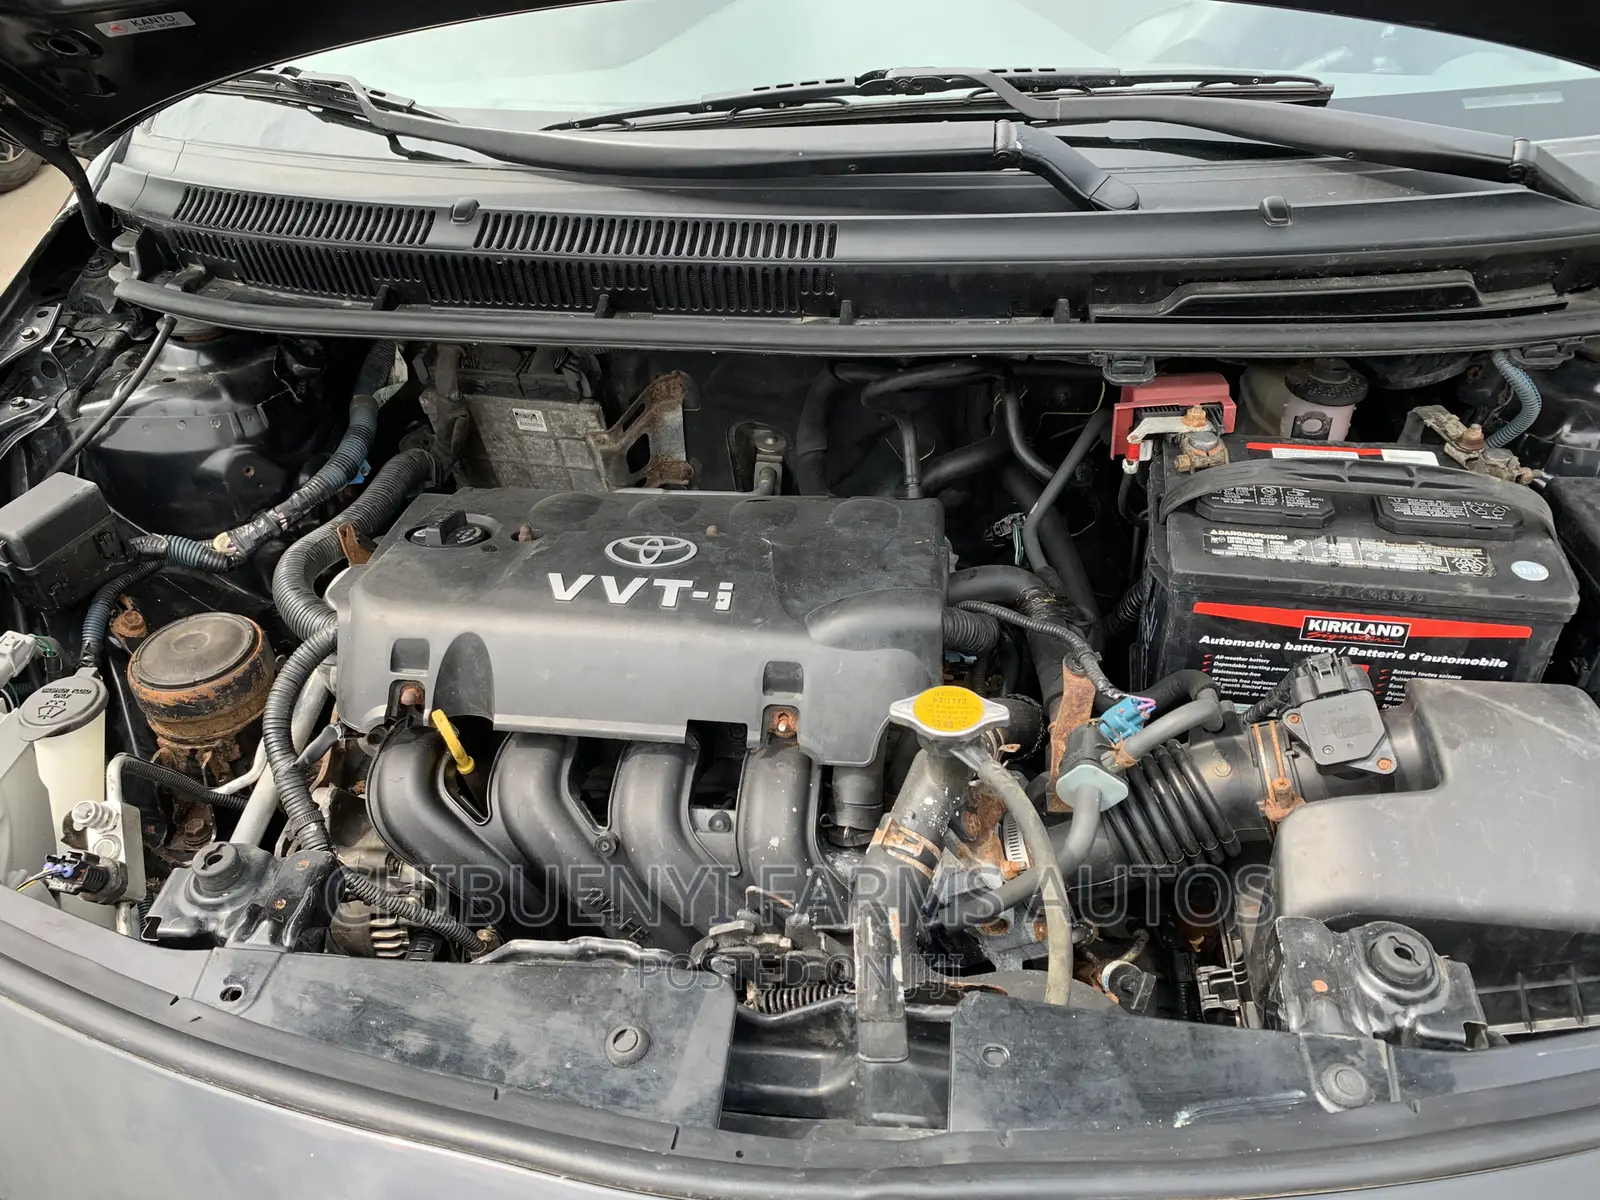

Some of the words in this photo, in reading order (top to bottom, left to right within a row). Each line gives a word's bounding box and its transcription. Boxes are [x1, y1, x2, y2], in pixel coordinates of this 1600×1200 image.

[130, 14, 175, 27] KANTO
[547, 572, 735, 611] VVT-i
[1308, 619, 1405, 638] KIRKLAND
[1199, 635, 1281, 650] Automotive
[1284, 641, 1337, 654] battery
[1338, 646, 1347, 655] /
[1348, 646, 1406, 660] Batterie
[1409, 651, 1509, 668] d'automobile
[1215, 654, 1248, 662] All-weather
[1249, 656, 1270, 664] battery
[1212, 668, 1262, 677] Maintenance-free
[1213, 661, 1247, 669] Dependable
[1248, 664, 1271, 672] starting
